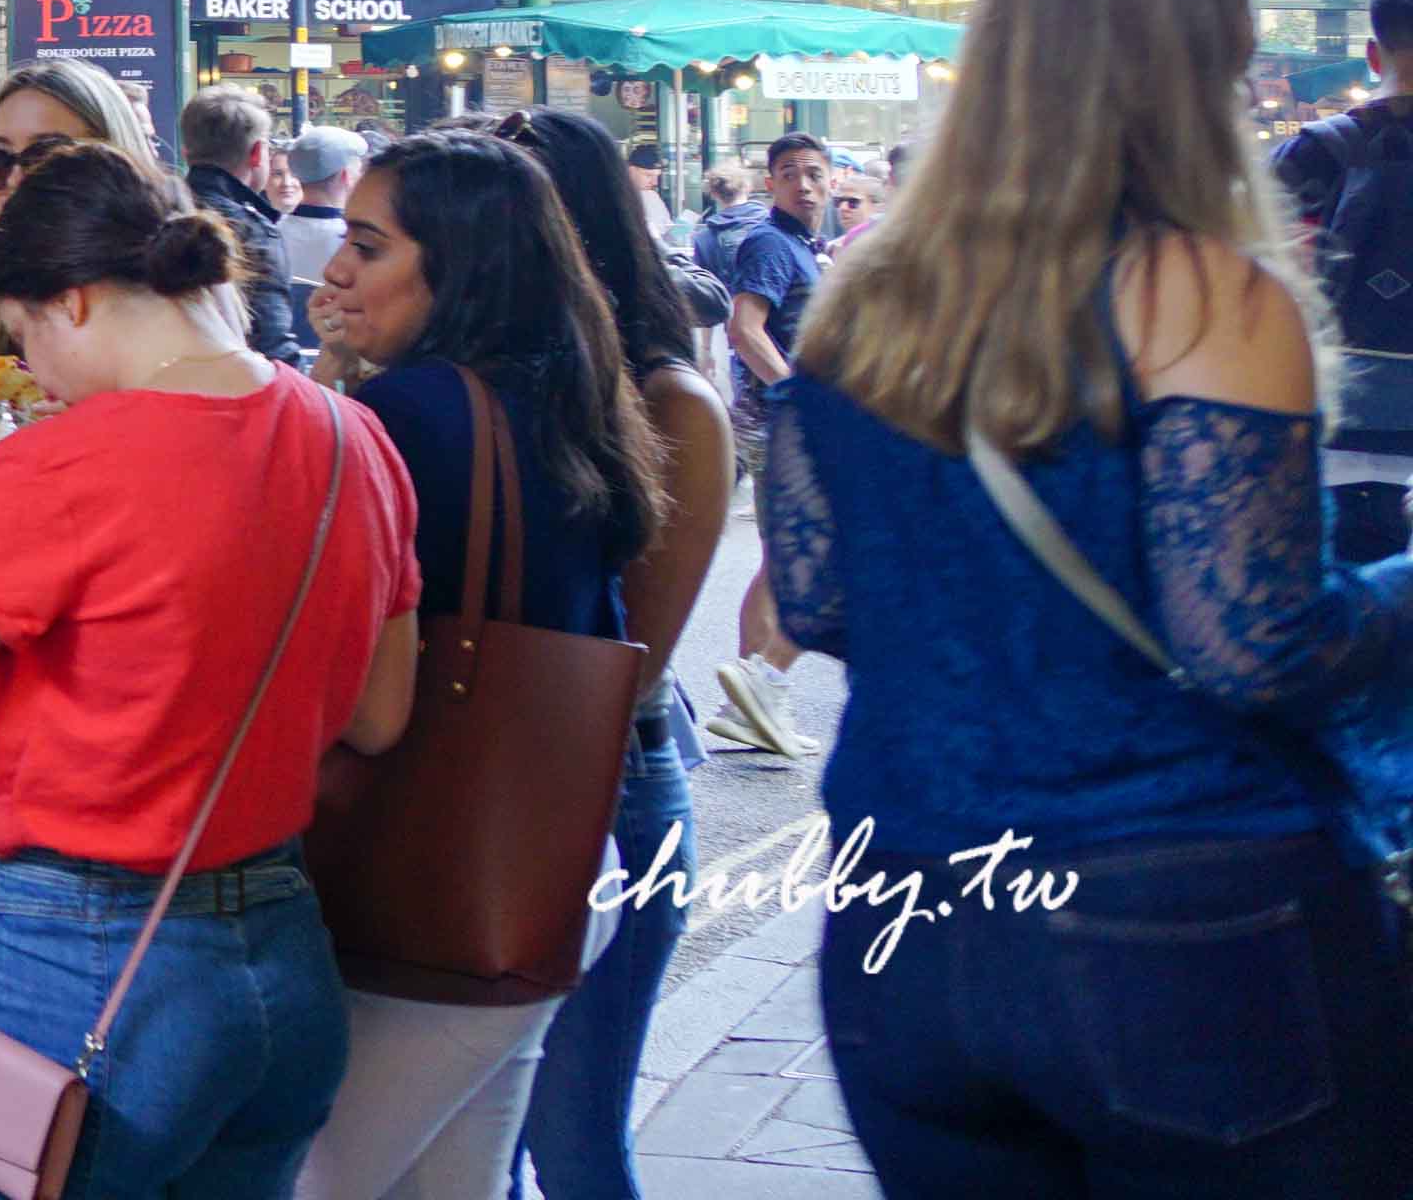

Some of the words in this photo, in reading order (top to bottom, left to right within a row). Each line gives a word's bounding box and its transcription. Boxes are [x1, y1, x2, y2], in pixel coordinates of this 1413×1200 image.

[315, 0, 412, 21] SCHOOL
[36, 48, 117, 59] SOURDOUGH
[118, 47, 156, 57] PIZZA
[776, 71, 902, 95] DOUGHNUTS
